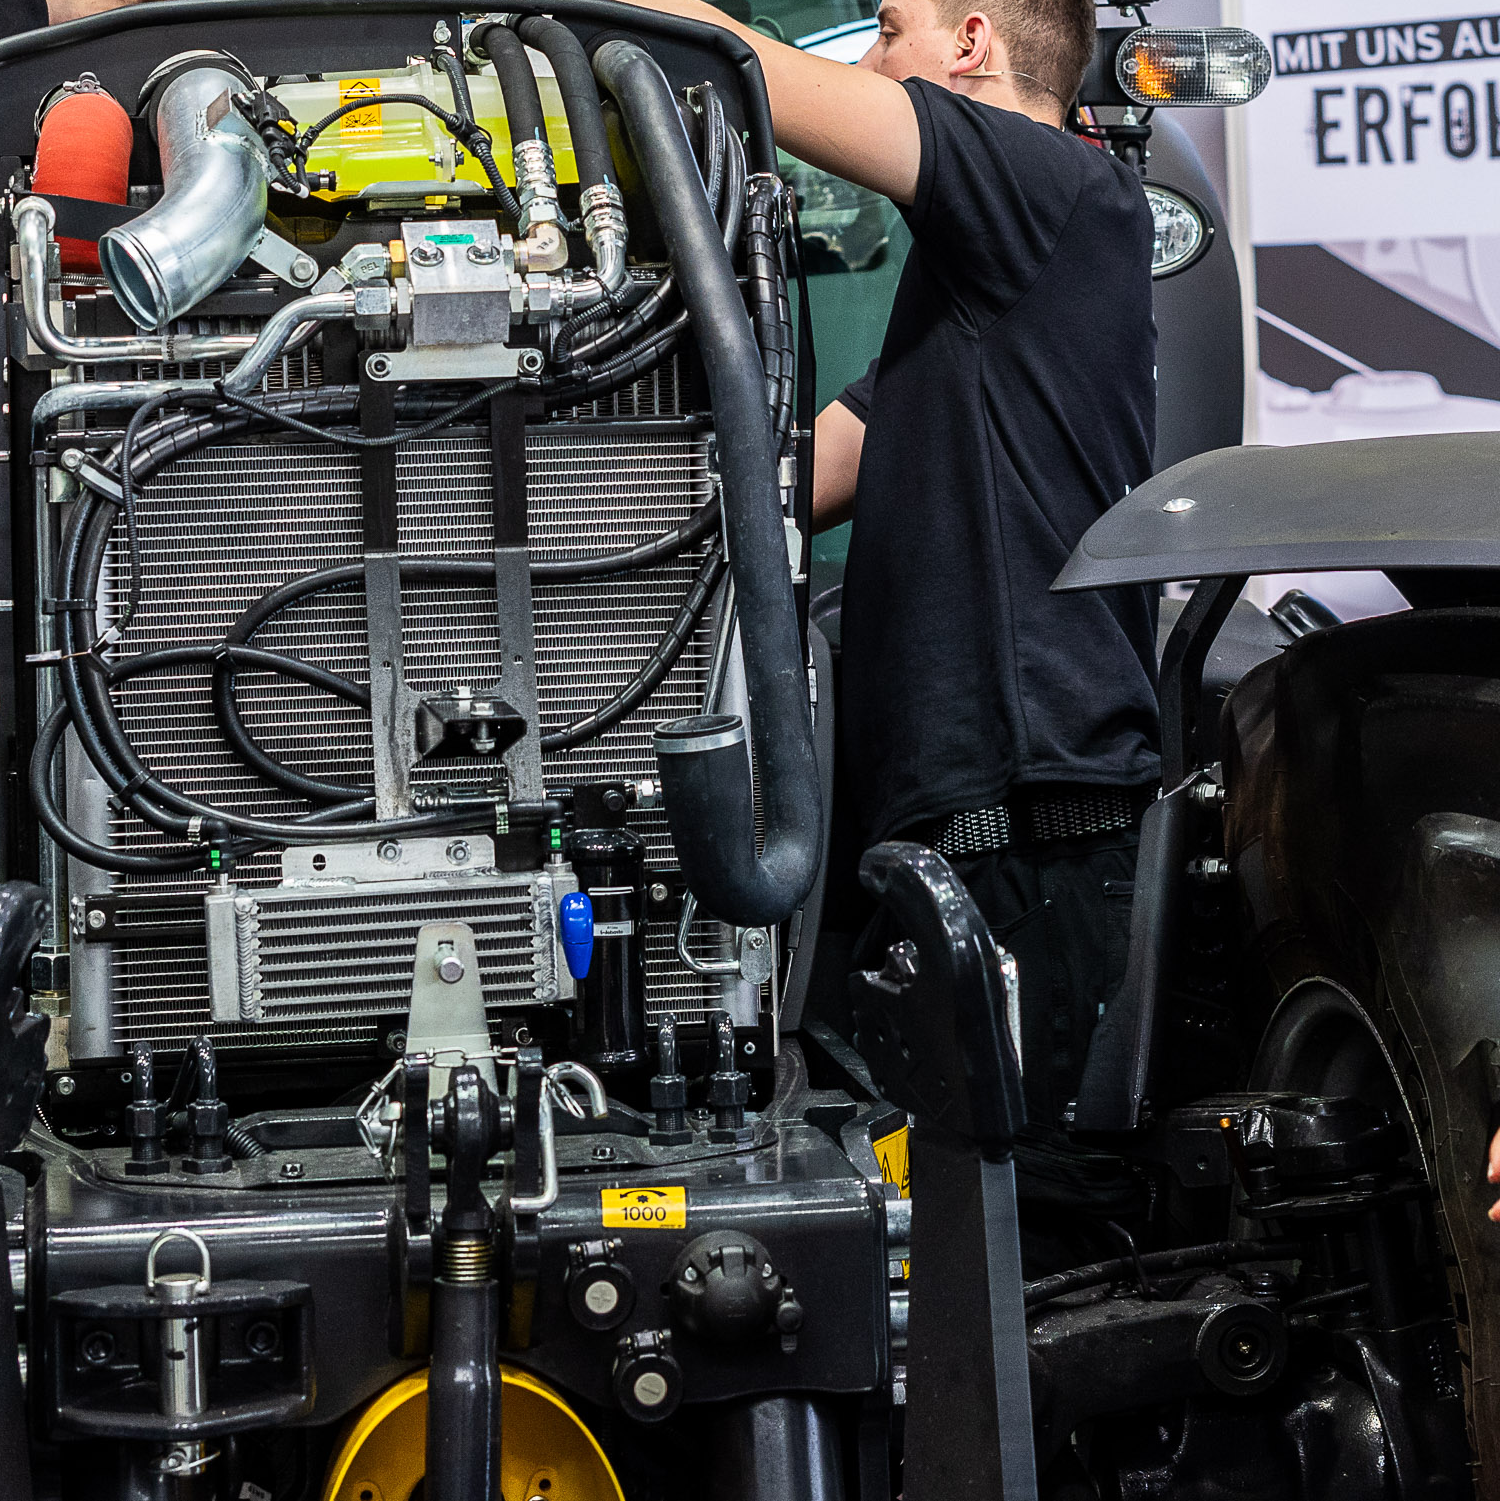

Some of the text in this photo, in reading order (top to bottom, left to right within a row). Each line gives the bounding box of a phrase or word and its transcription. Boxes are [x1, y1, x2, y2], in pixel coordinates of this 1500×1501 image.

[1276, 31, 1348, 73] MIT
[1355, 24, 1444, 66] UNS
[621, 1206, 667, 1222] 1000
